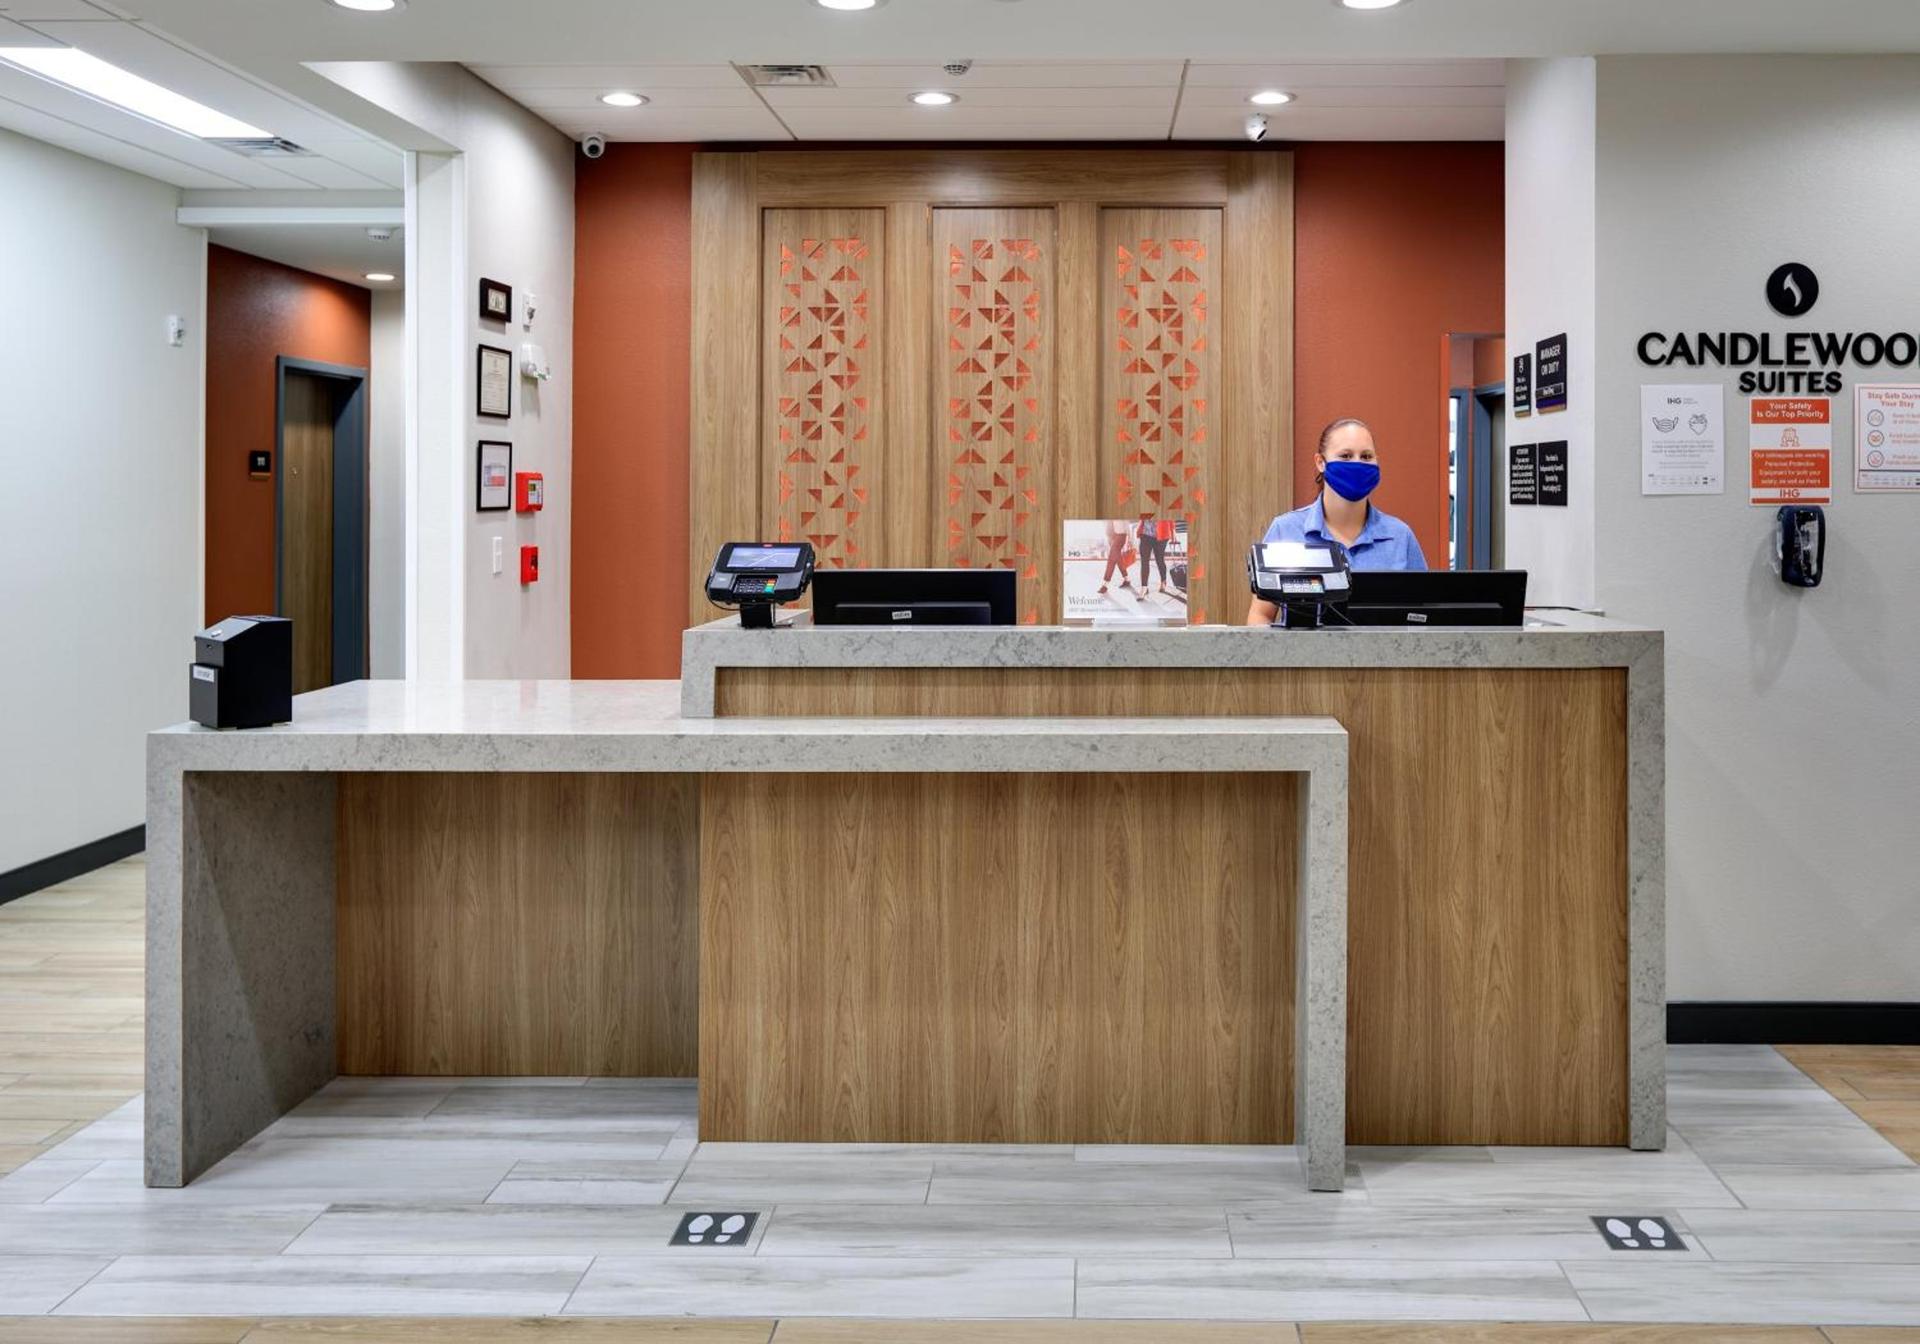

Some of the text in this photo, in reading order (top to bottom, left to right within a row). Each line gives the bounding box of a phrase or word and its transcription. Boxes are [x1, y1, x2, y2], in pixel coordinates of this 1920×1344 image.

[1540, 344, 1561, 360] MANAGER
[1637, 332, 1920, 366] CANDLEWOO
[1541, 361, 1560, 376] ON DUTY
[1739, 371, 1842, 393] SUITES
[1867, 392, 1883, 400] Stay
[1789, 402, 1812, 410] Safety
[1797, 411, 1823, 419] Priority
[1779, 489, 1800, 498] IHG
[1068, 596, 1104, 605] Welcome
